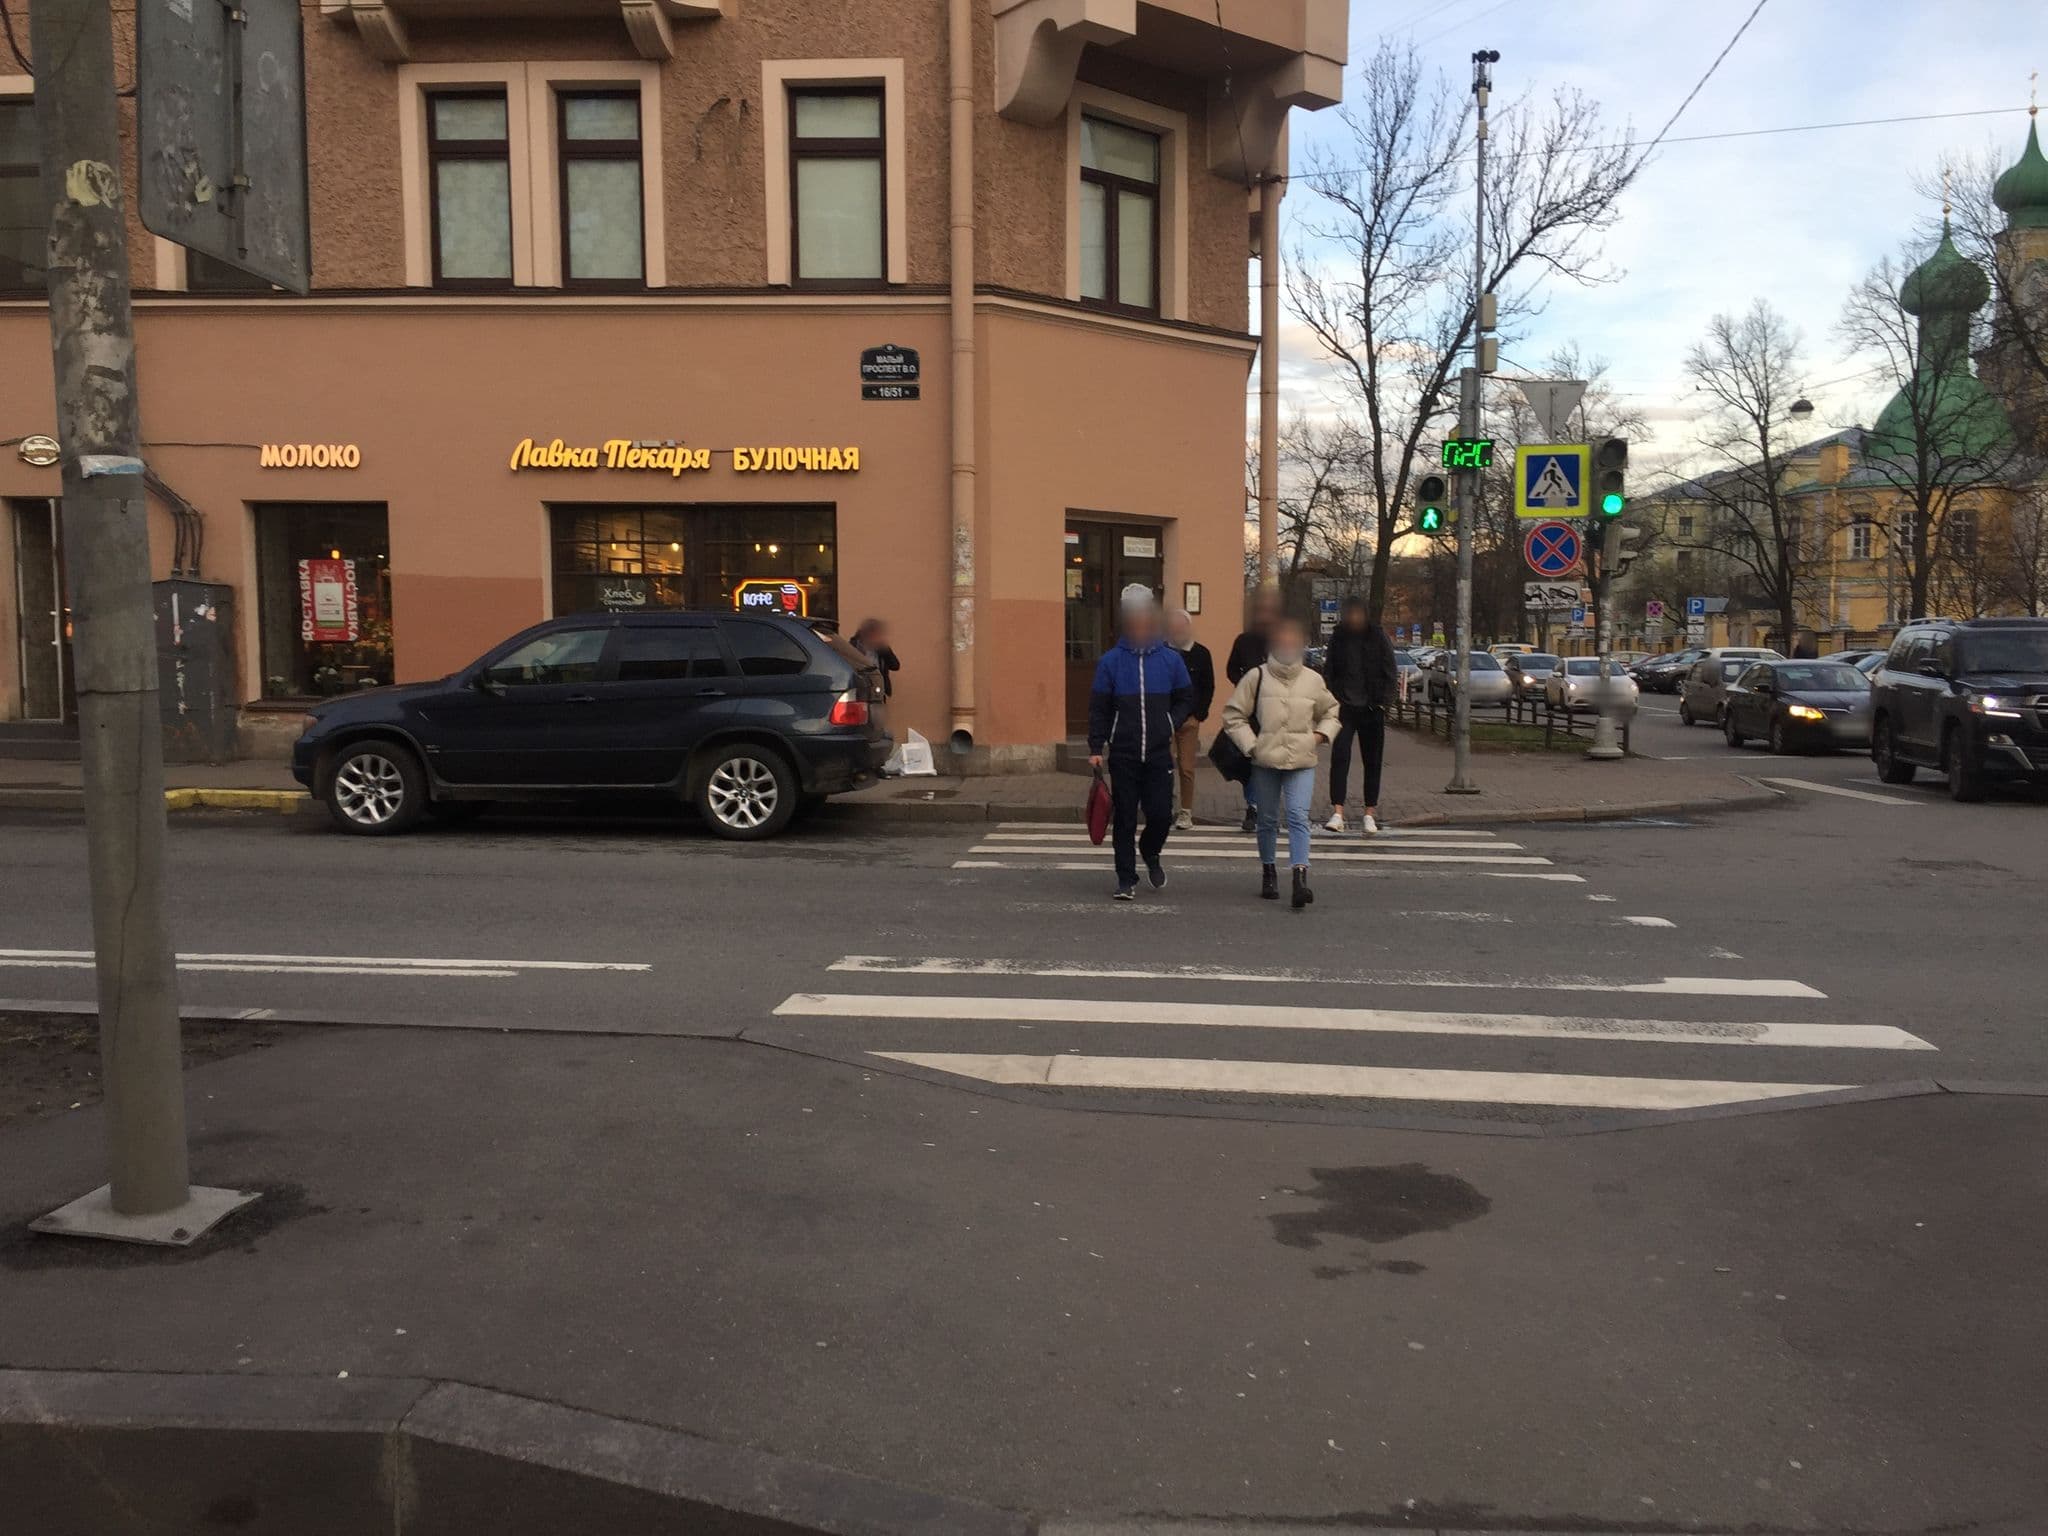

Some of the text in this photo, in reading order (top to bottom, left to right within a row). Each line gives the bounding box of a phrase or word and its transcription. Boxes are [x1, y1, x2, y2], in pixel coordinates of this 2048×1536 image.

[510, 438, 711, 477] Лавка Пекаря
[733, 447, 860, 471] БУЛОЧНАЯ
